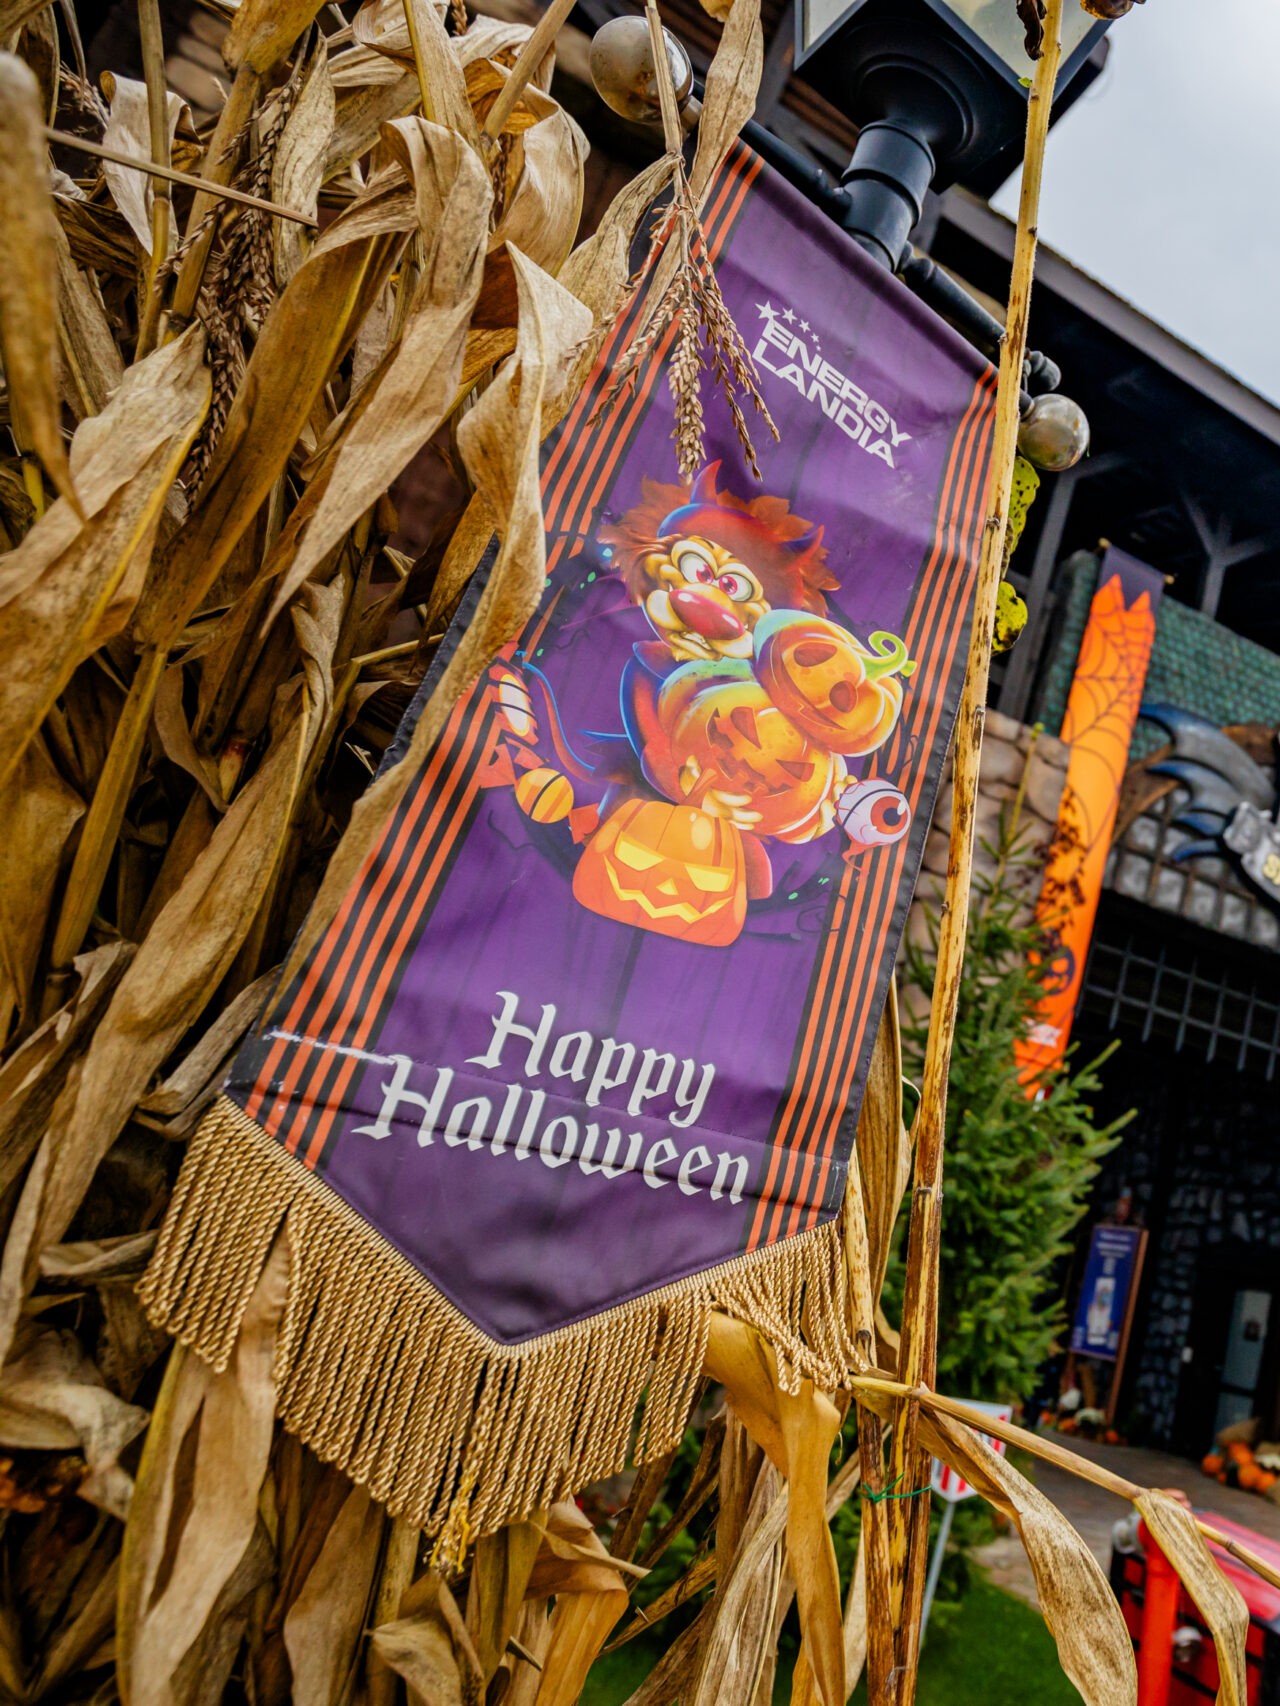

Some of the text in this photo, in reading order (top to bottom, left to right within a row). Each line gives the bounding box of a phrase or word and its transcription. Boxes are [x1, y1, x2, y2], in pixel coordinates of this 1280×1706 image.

[752, 338, 895, 469] LANDIA
[761, 318, 912, 448] ENERGY
[464, 990, 716, 1128] Happy
[350, 1054, 749, 1205] Halloween
